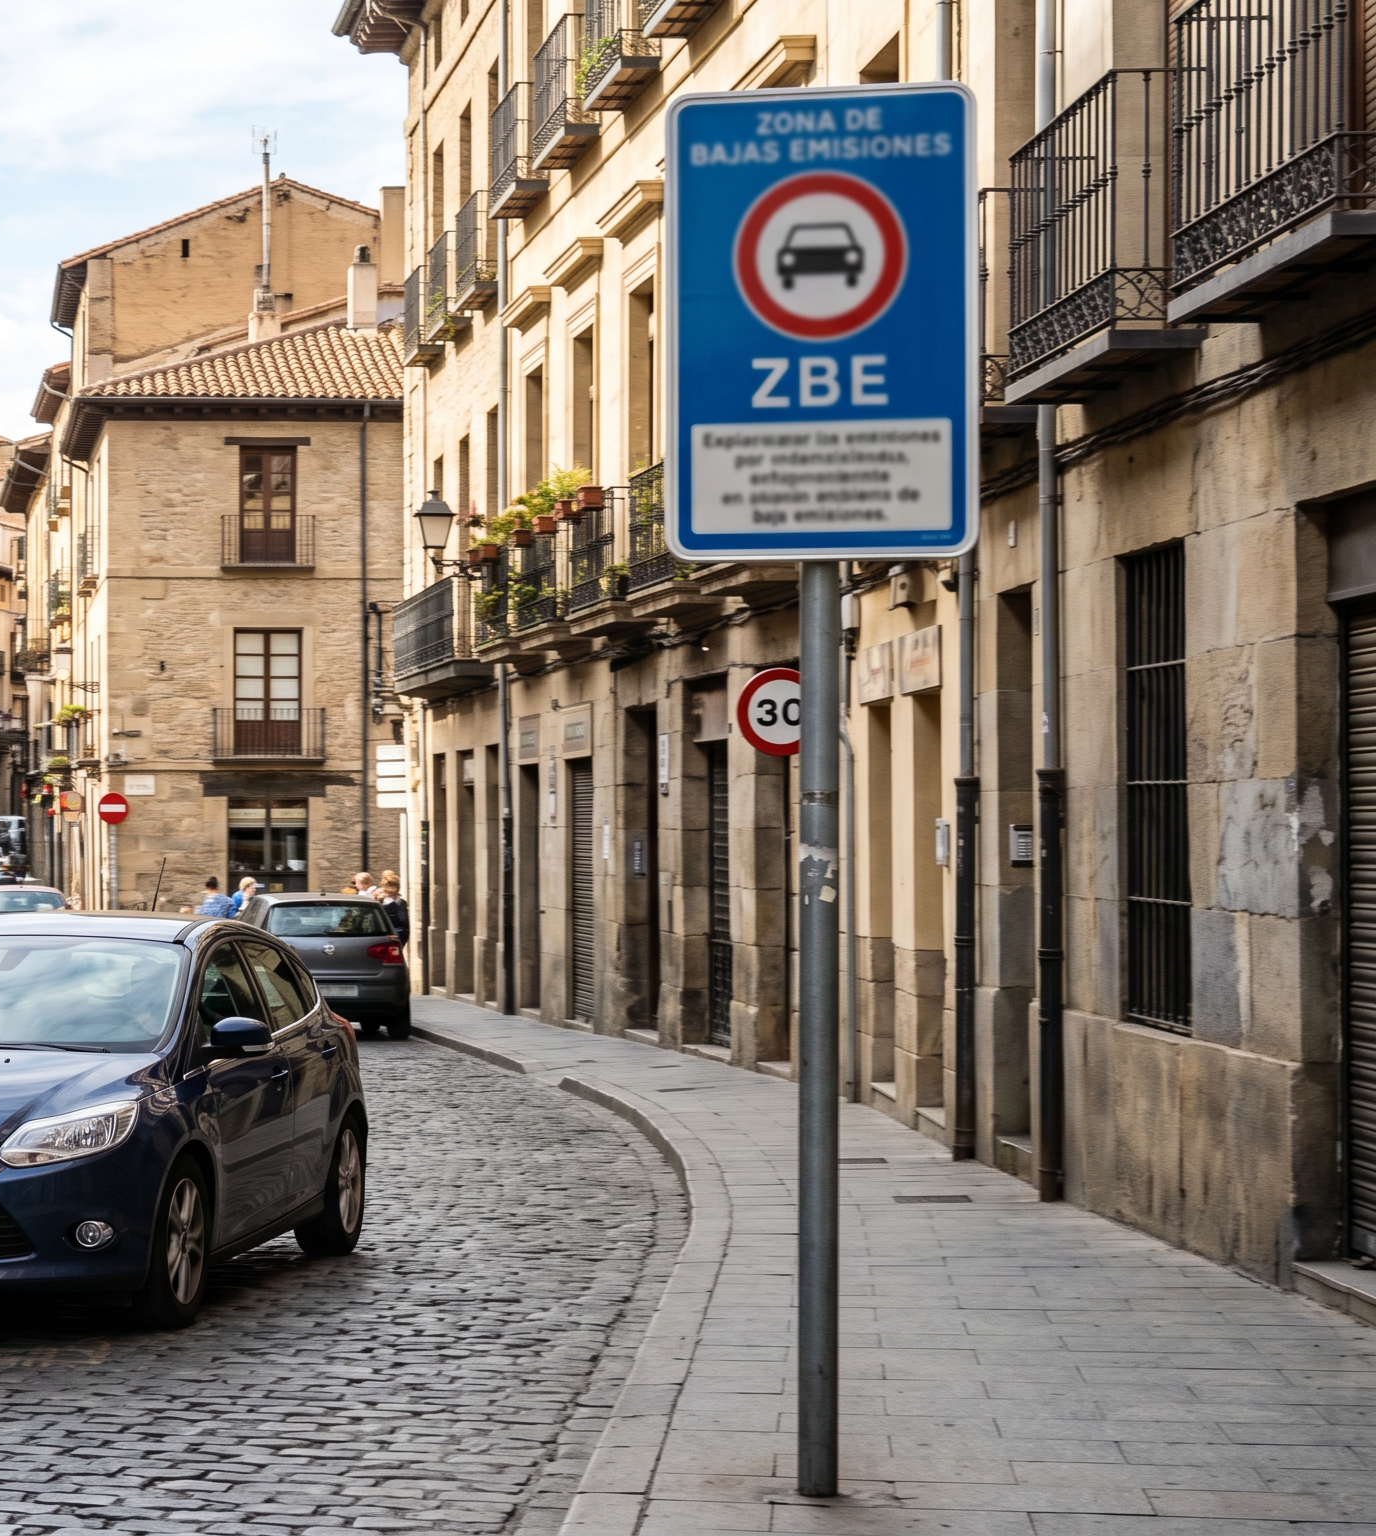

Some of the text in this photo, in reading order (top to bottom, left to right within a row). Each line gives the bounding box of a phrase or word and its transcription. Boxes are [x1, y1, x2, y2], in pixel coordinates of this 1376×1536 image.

[756, 107, 882, 136] ZONA DE
[690, 132, 952, 166] BAJAS EMISIONES
[751, 354, 889, 408] ZBE
[897, 487, 920, 503] de
[756, 698, 801, 727] 30
